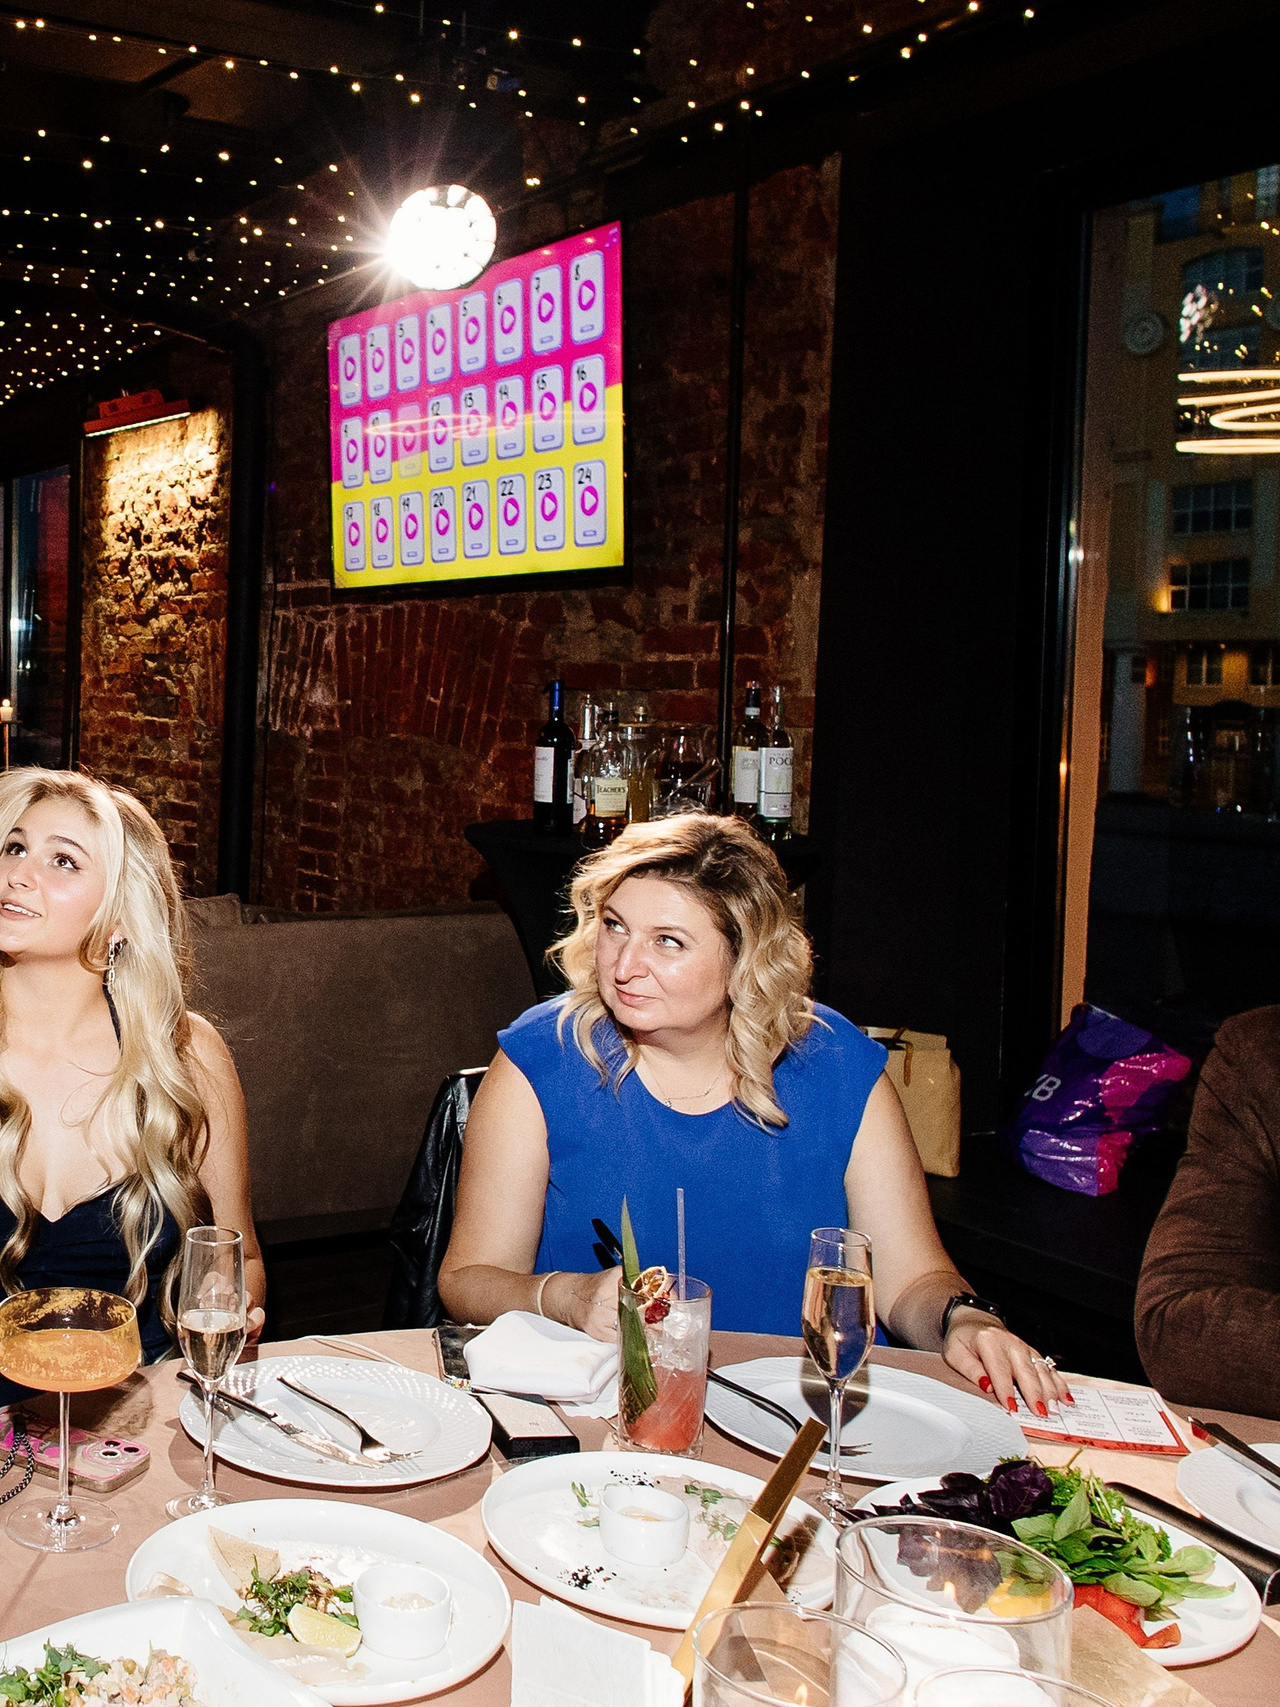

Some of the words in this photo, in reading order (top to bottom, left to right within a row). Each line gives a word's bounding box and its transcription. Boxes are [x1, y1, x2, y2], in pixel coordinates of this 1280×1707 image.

[576, 363, 587, 382] 16
[536, 373, 547, 391] 15
[431, 401, 441, 416] 12
[537, 473, 552, 491] 23
[577, 466, 592, 485] 24
[466, 486, 476, 502] 21
[500, 479, 514, 497] 22
[433, 491, 445, 508] 20
